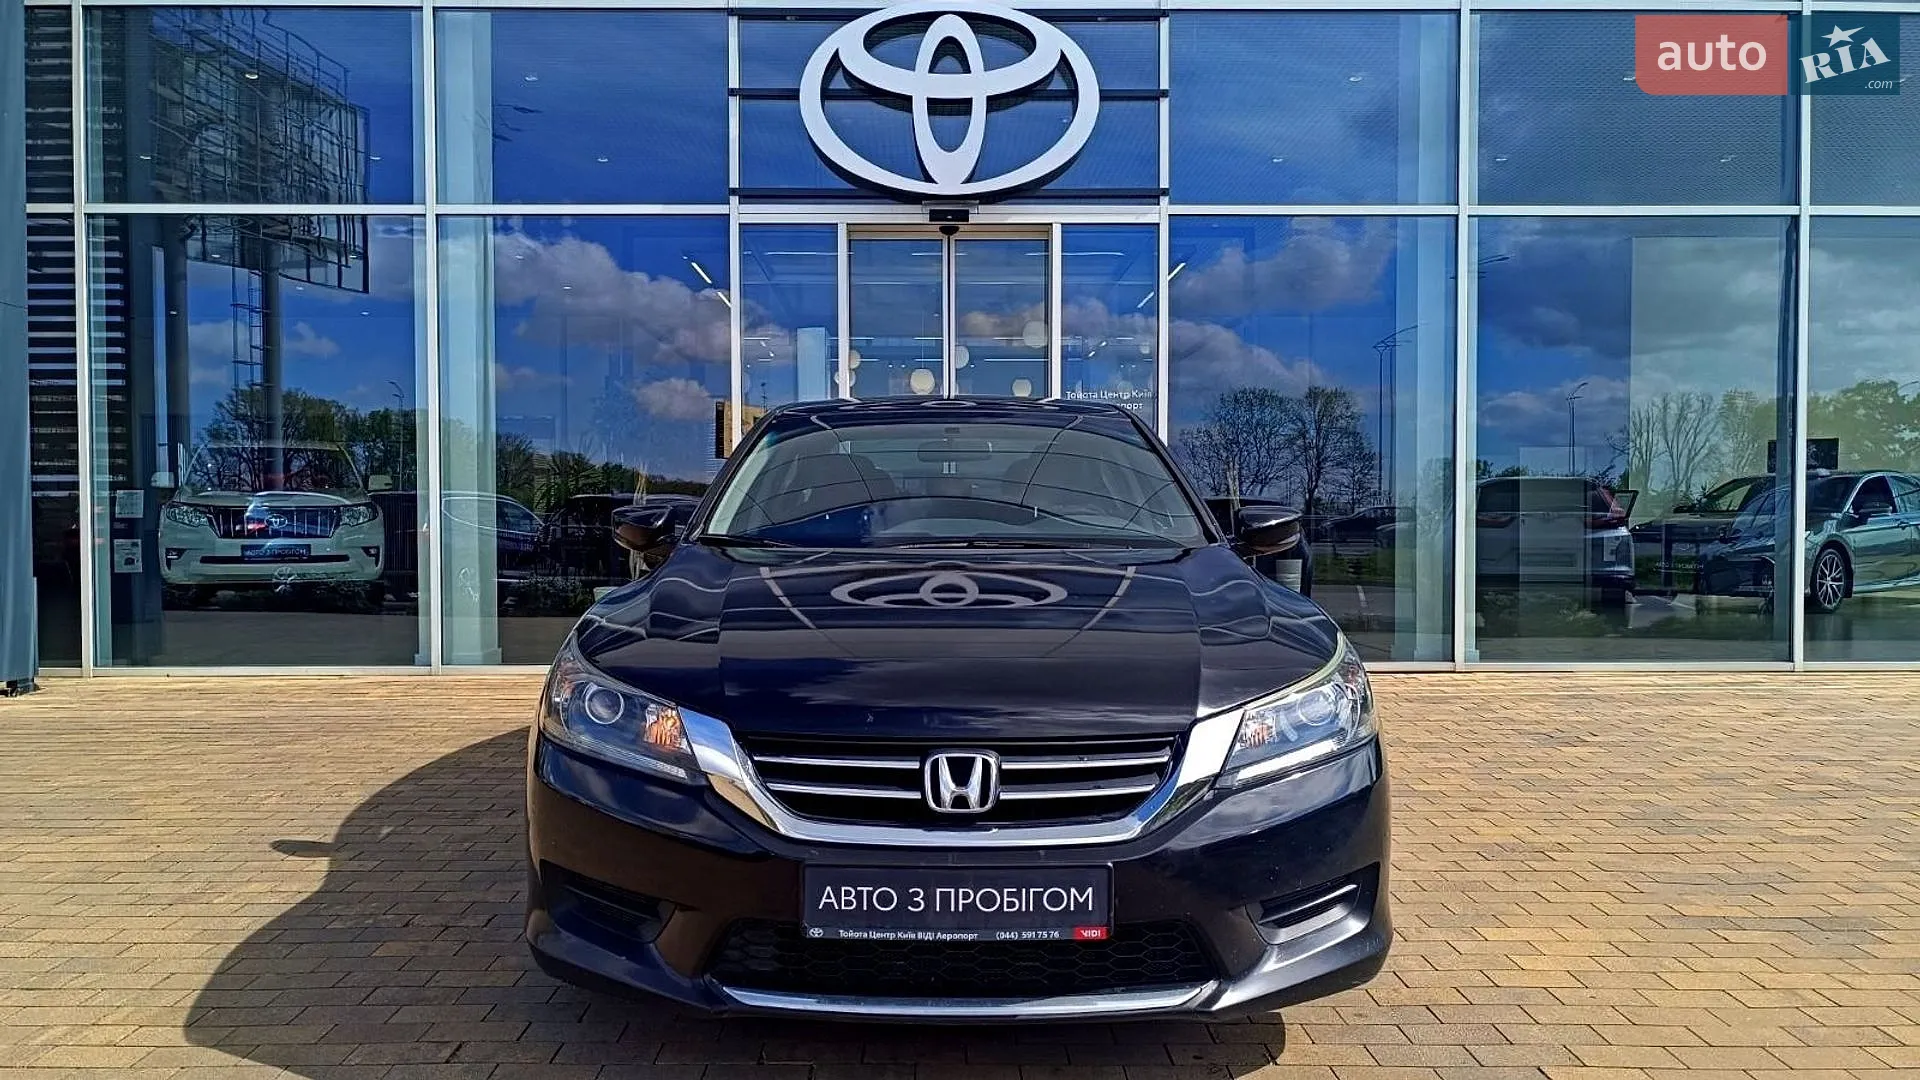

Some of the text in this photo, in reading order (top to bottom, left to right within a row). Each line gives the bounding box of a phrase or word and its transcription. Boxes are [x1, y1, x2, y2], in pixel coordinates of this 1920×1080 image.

[1065, 390, 1098, 400] Тойота
[1100, 388, 1131, 400] Центр
[818, 886, 1094, 912] АВТО З ПРОБІГОМ
[838, 929, 868, 939] Тойота
[869, 930, 896, 941] Центр
[897, 930, 916, 940] Київ
[936, 931, 979, 942] Аеропорт
[995, 931, 1019, 941] (044)
[1080, 929, 1101, 938] VIDI
